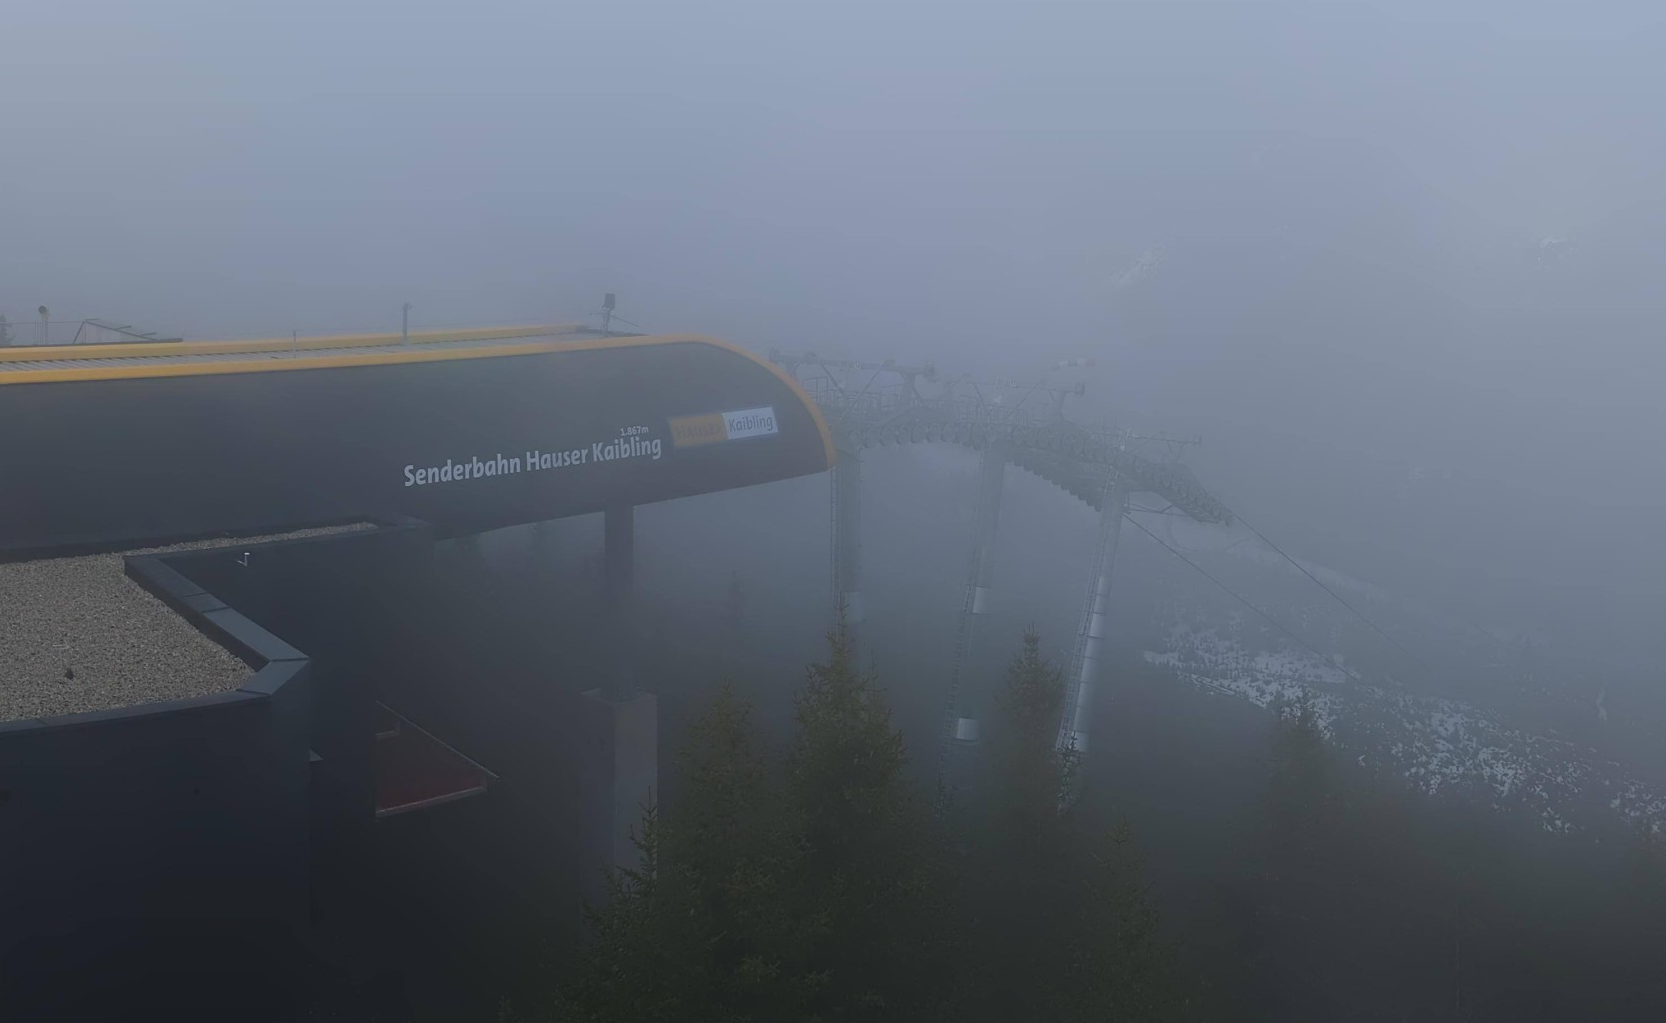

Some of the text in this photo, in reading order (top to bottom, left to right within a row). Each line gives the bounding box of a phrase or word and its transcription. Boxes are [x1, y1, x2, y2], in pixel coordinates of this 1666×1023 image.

[619, 425, 649, 437] 1.867m
[728, 416, 773, 433] Kaibling
[404, 436, 662, 487] Senderbahn Hauser Kaibling
